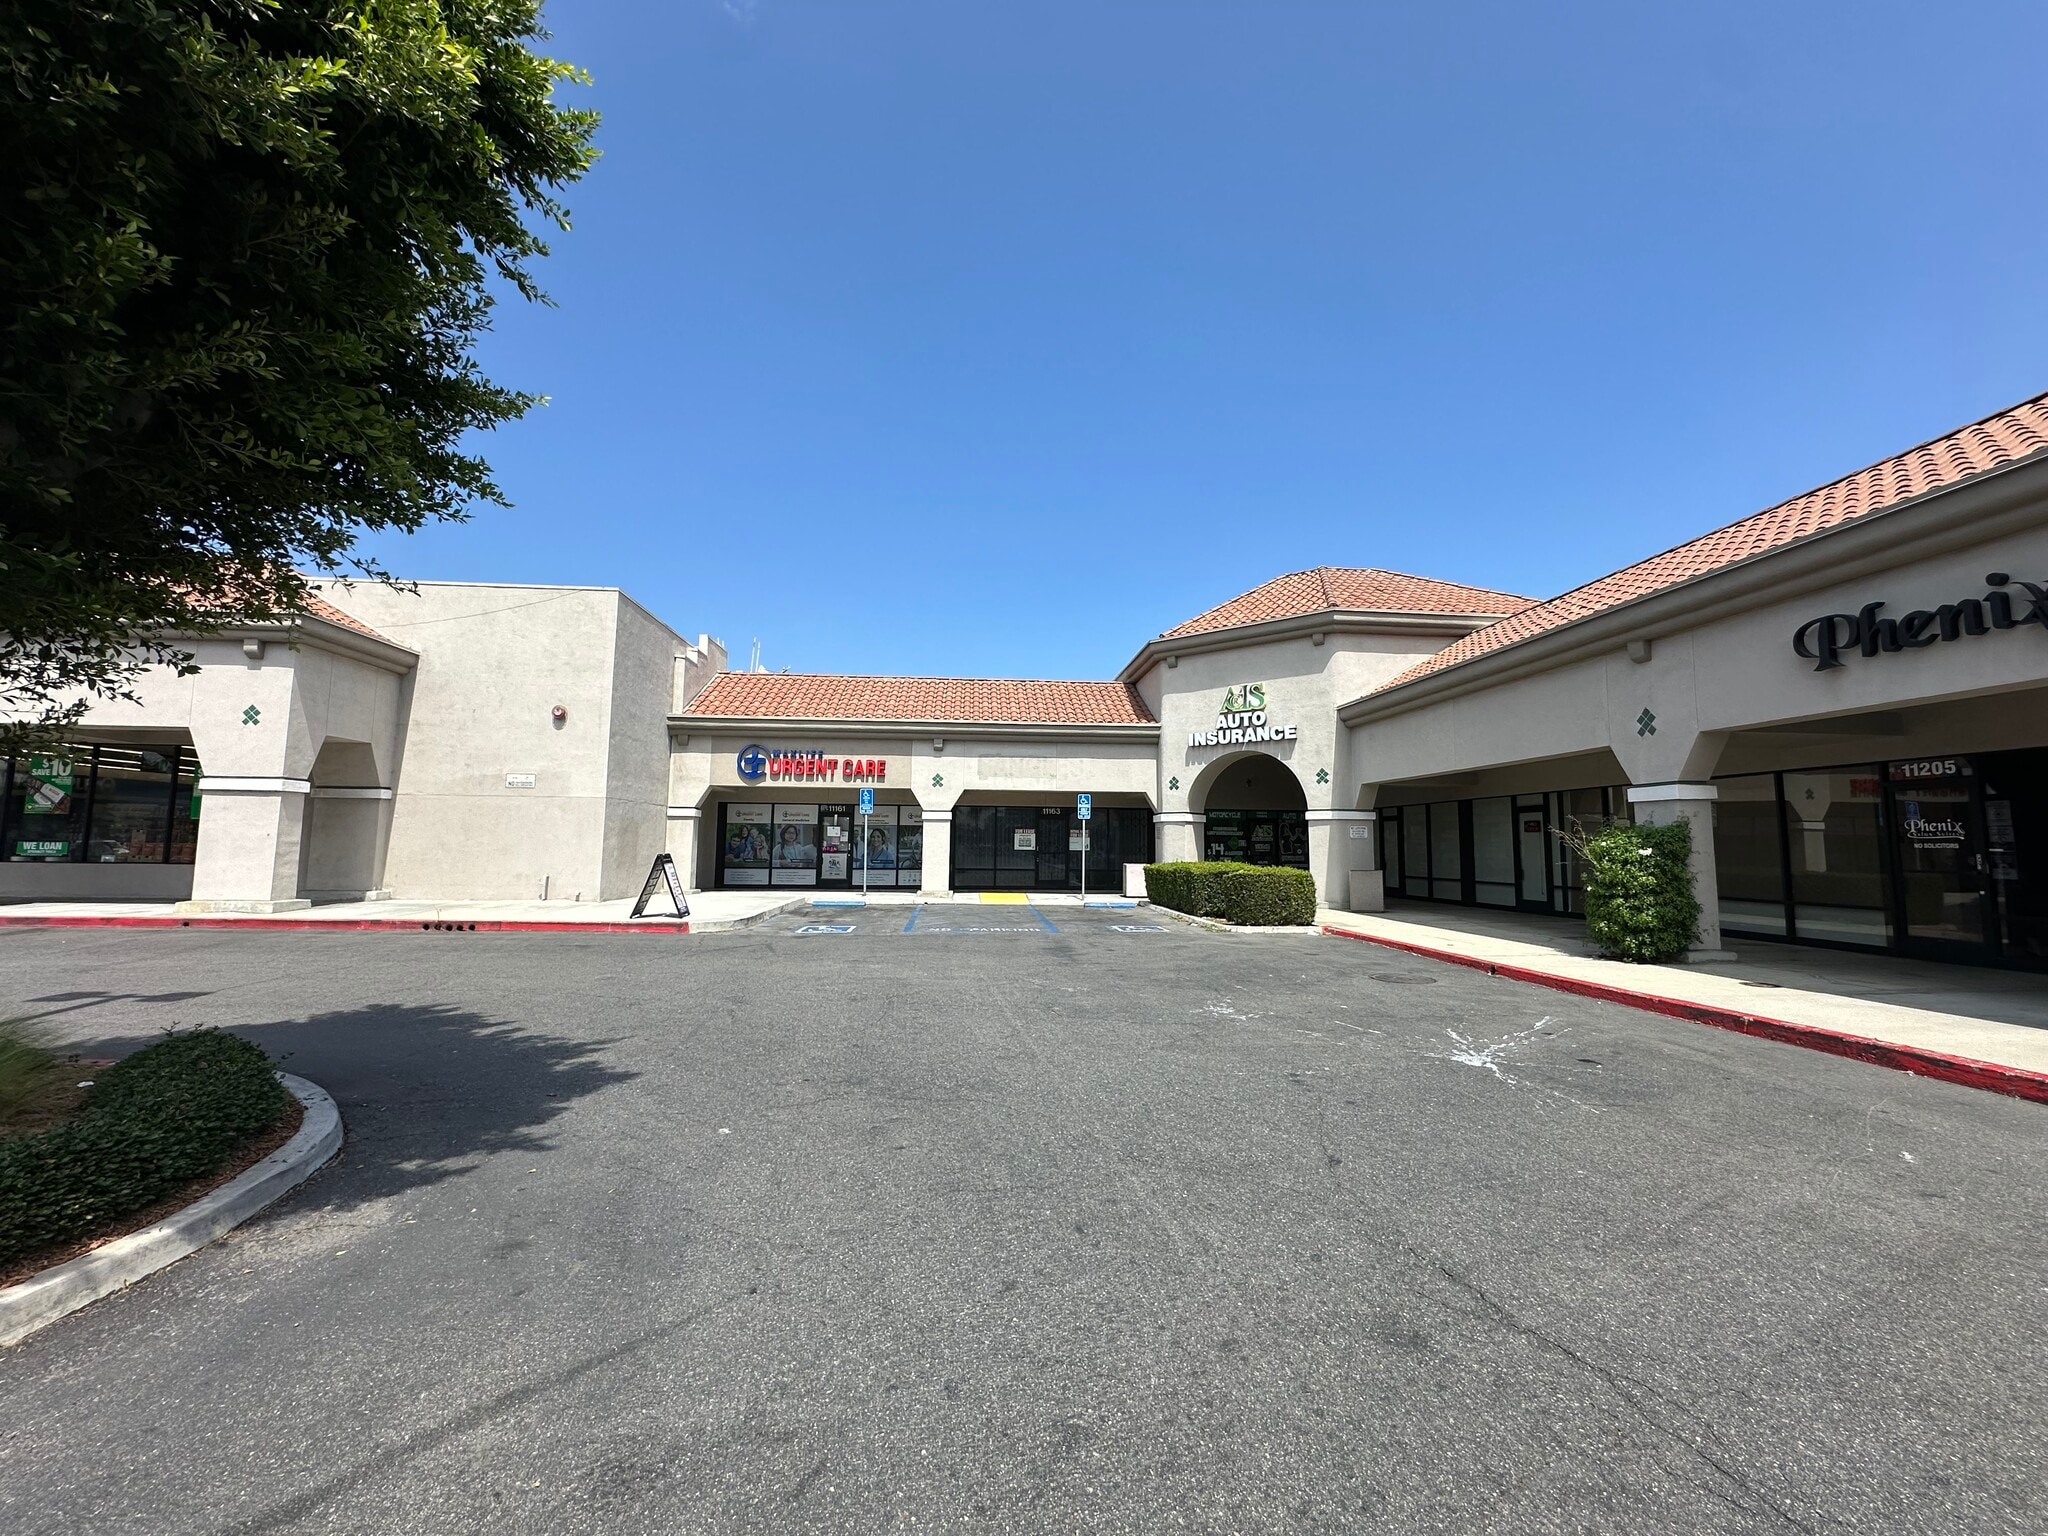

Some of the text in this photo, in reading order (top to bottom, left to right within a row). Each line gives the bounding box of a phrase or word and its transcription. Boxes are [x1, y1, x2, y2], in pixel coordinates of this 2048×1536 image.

[1216, 711, 1267, 729] AUTO
[1188, 725, 1297, 747] INSURANCE
[32, 768, 51, 776] SAVE
[769, 758, 886, 776] URGENT CARE
[1901, 760, 1957, 777] 11205
[1904, 818, 1966, 835] Phenix
[23, 841, 62, 850] WE LOAN
[1207, 843, 1225, 855] $14
